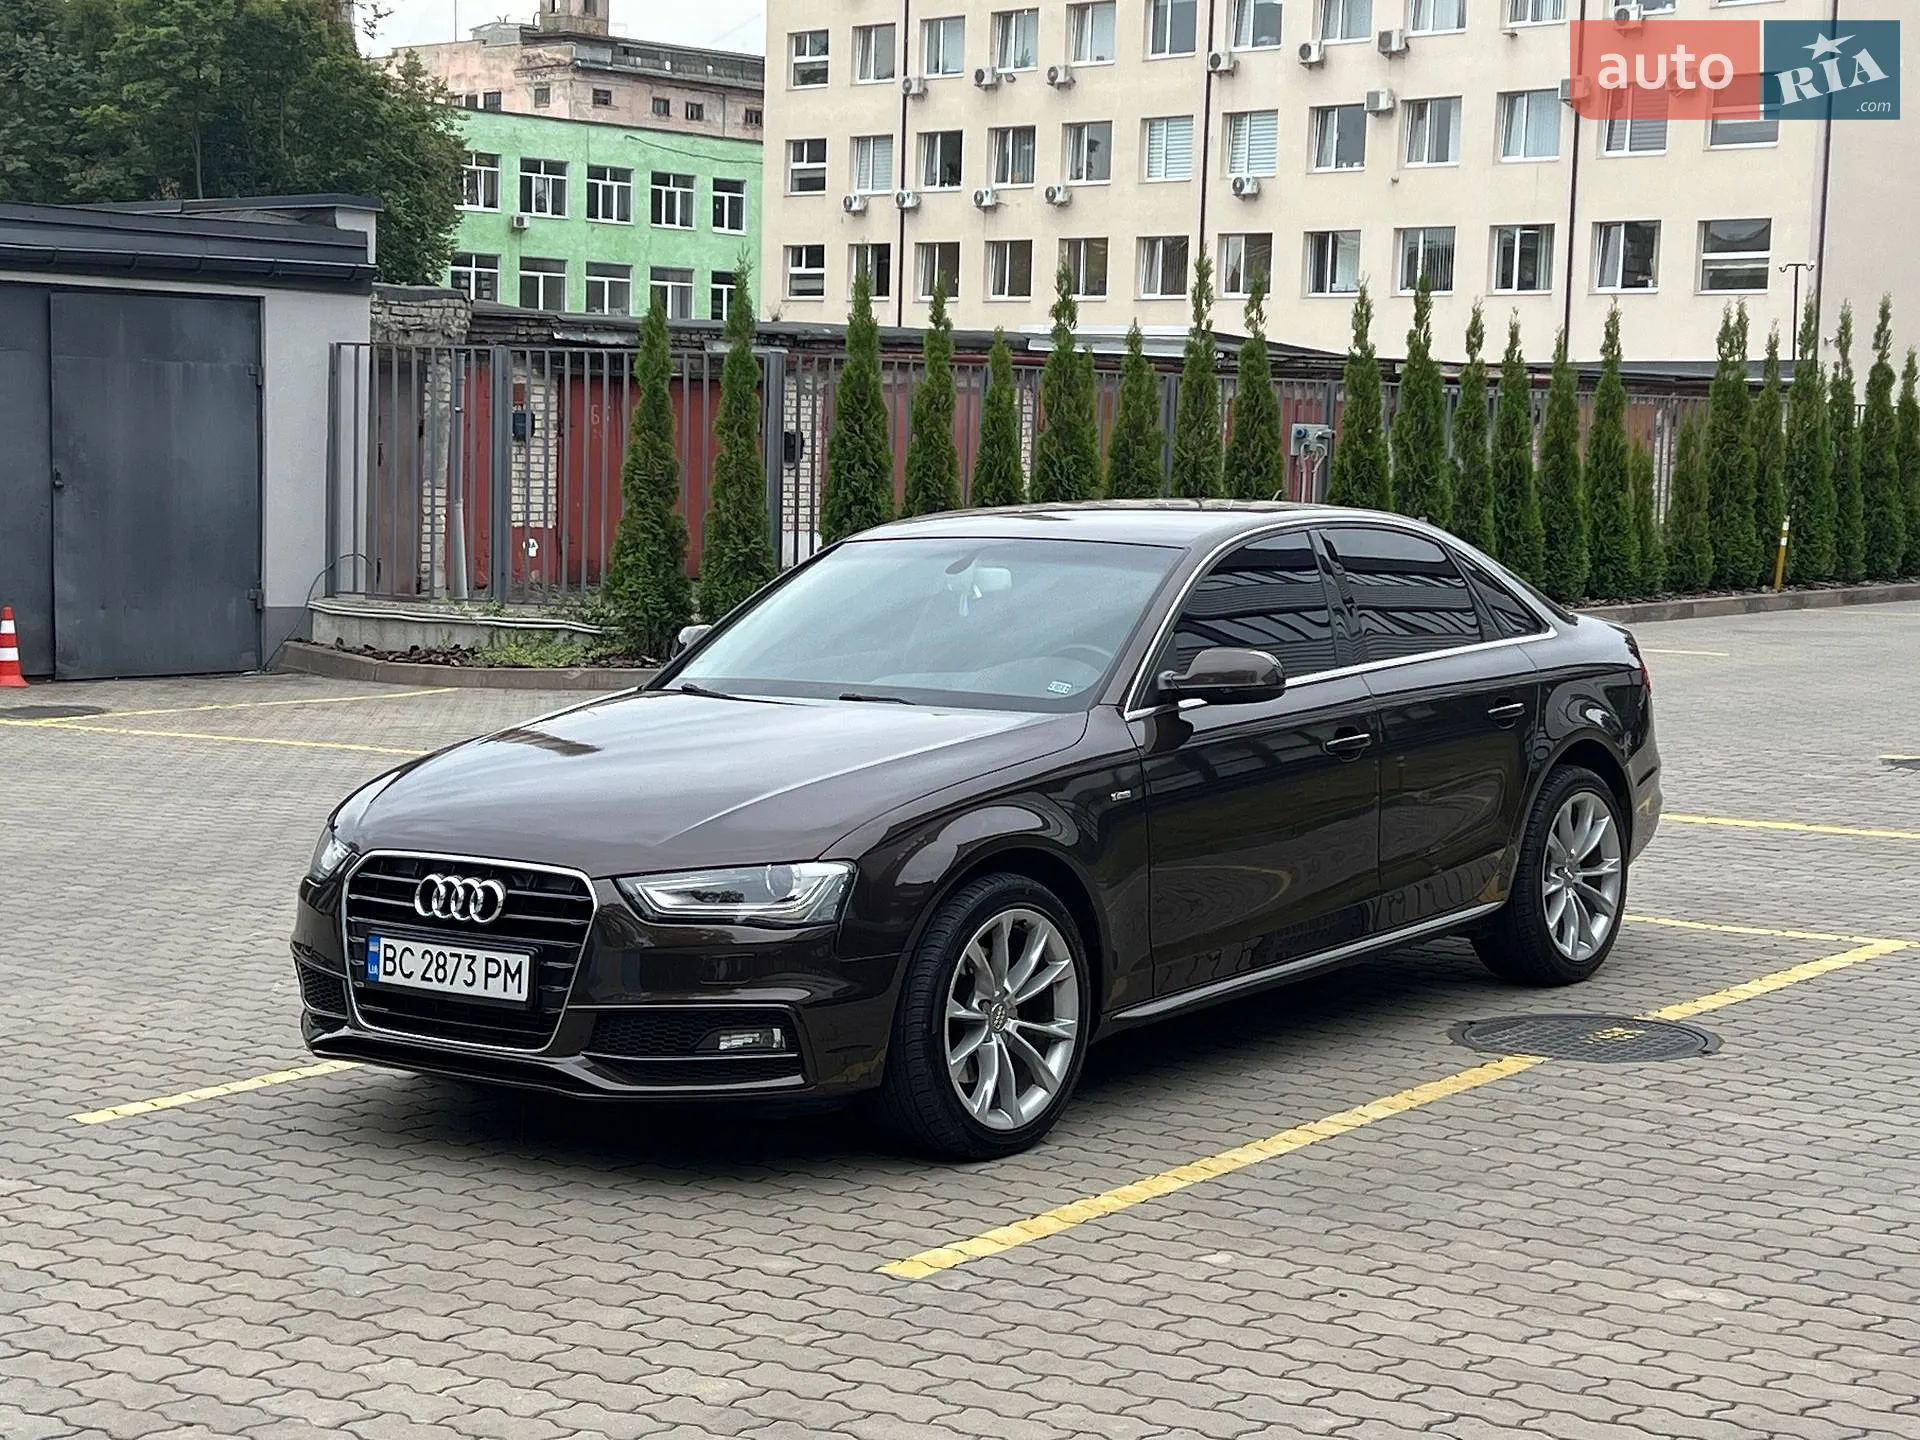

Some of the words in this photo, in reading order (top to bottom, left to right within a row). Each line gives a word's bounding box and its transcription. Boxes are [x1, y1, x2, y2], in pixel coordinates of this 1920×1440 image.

[383, 943, 415, 979] BC
[420, 949, 477, 987] 2873
[484, 957, 523, 994] PM
